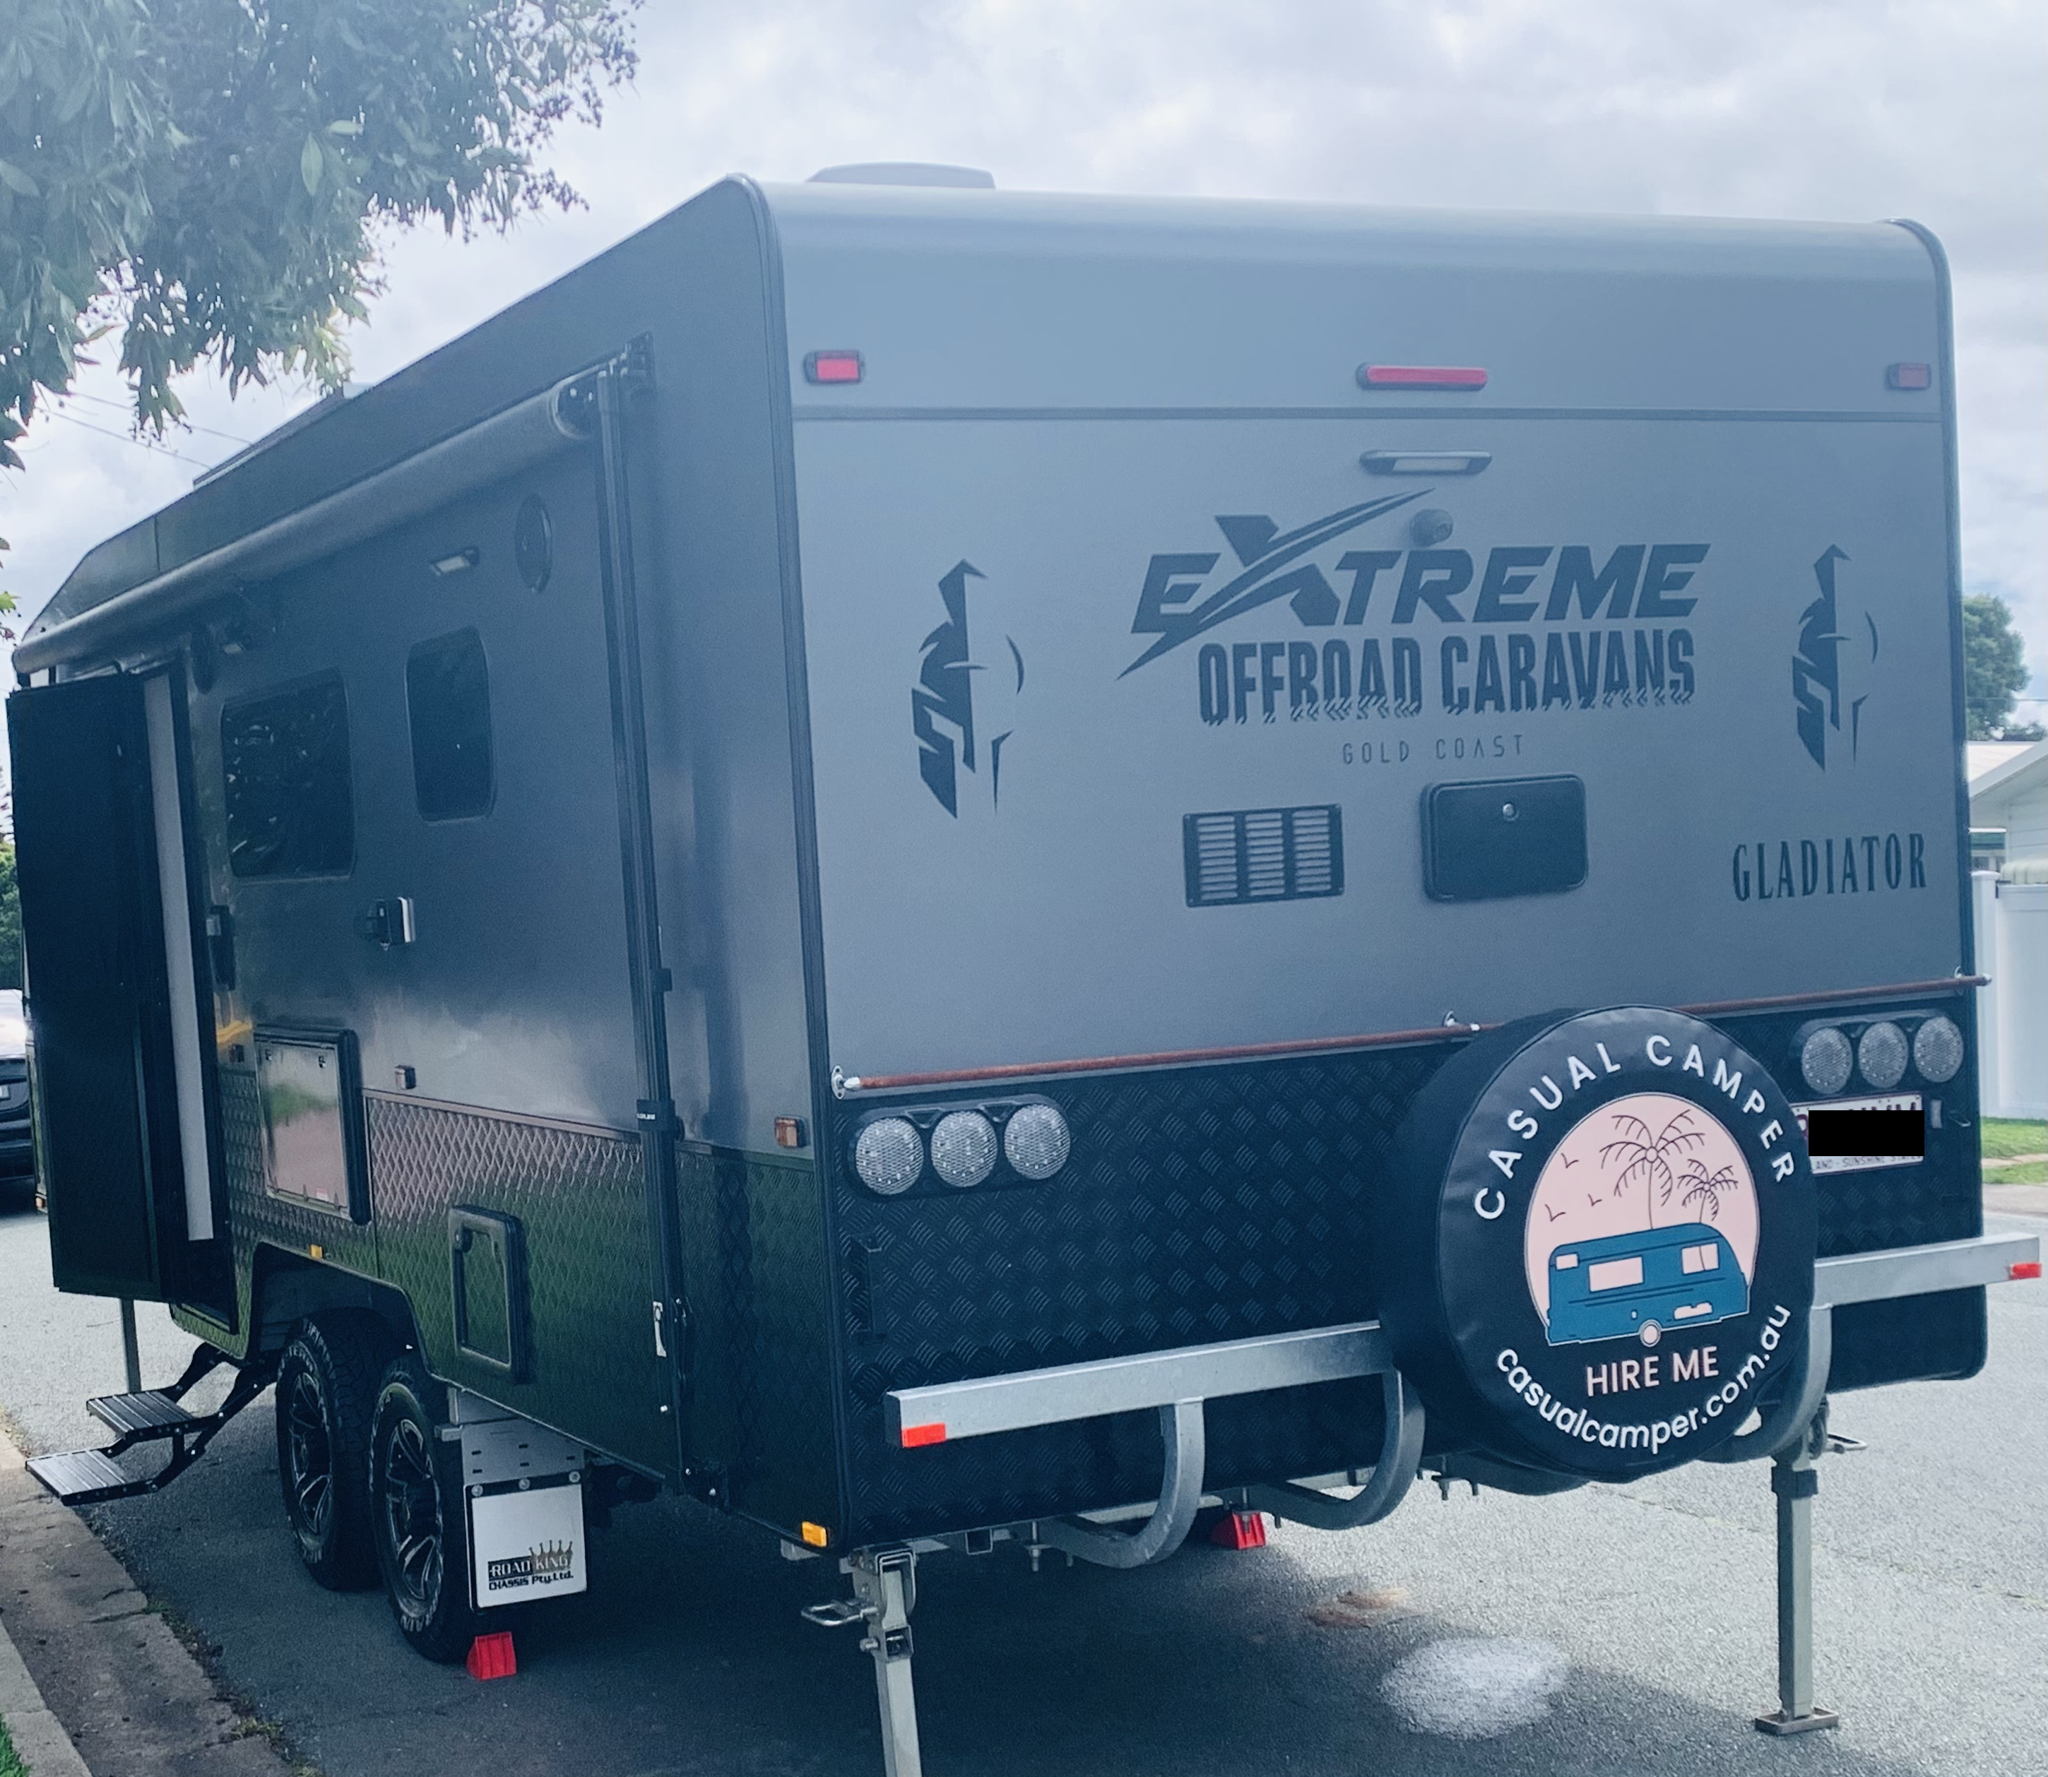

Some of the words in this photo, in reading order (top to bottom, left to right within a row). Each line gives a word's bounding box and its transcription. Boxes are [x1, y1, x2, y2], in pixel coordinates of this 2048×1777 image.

[1116, 488, 1711, 681] EXTREME
[1199, 636, 1422, 726] OFFROAD
[1440, 628, 1696, 715] CARAVANS
[1342, 741, 1410, 765] GOLD
[1435, 734, 1523, 760] COAST
[1732, 833, 1926, 901] GLADIATOR
[1474, 1042, 1621, 1220] CASUAL
[1646, 1035, 1796, 1183] CAMPER
[1497, 1304, 1791, 1454] casualcamper.com.au
[1586, 1356, 1659, 1397] HIRE
[1673, 1346, 1719, 1380] ME
[489, 1577, 529, 1590] CHASSIS
[490, 1560, 531, 1577] ROAD
[535, 1555, 568, 1570] KING
